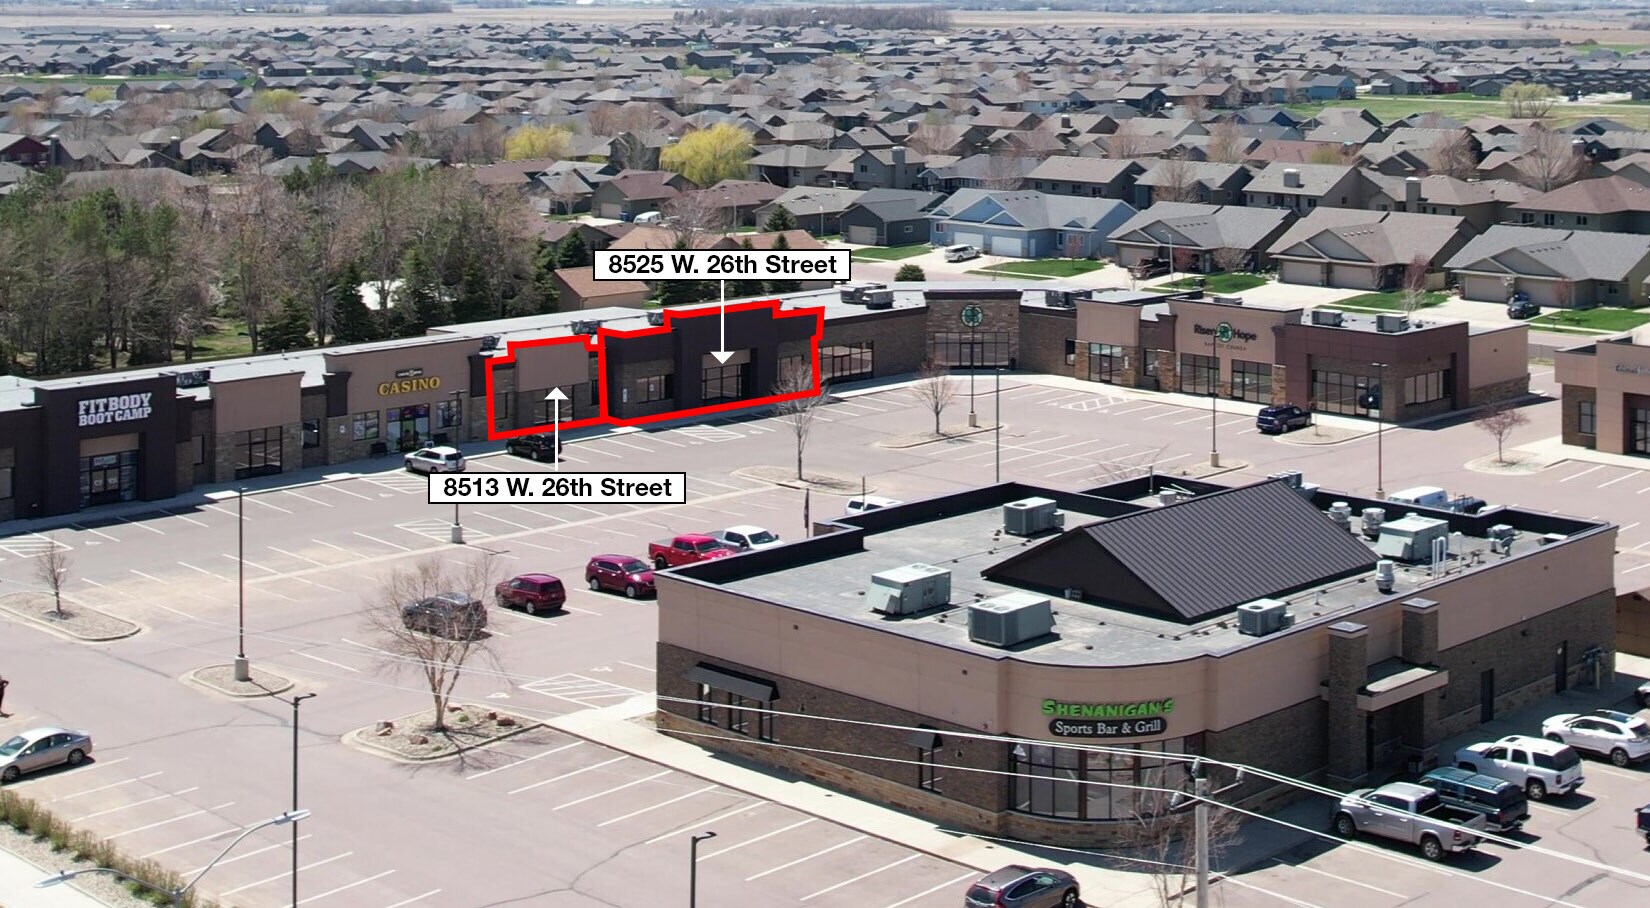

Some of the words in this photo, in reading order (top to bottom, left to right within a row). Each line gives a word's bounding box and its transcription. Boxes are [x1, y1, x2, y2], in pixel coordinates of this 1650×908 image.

[1194, 324, 1217, 336] Risen
[1233, 329, 1257, 343] Hope
[378, 376, 441, 396] CASINO
[78, 398, 108, 414] FIT
[108, 392, 152, 411] BODY
[78, 411, 114, 426] BOOT
[114, 406, 152, 422] CAMP
[1042, 698, 1175, 717] SHENANIGAN'S
[1055, 721, 1093, 735] Sports
[1097, 722, 1119, 734] Bar
[1121, 722, 1131, 734] &
[1135, 720, 1161, 733] Grill
